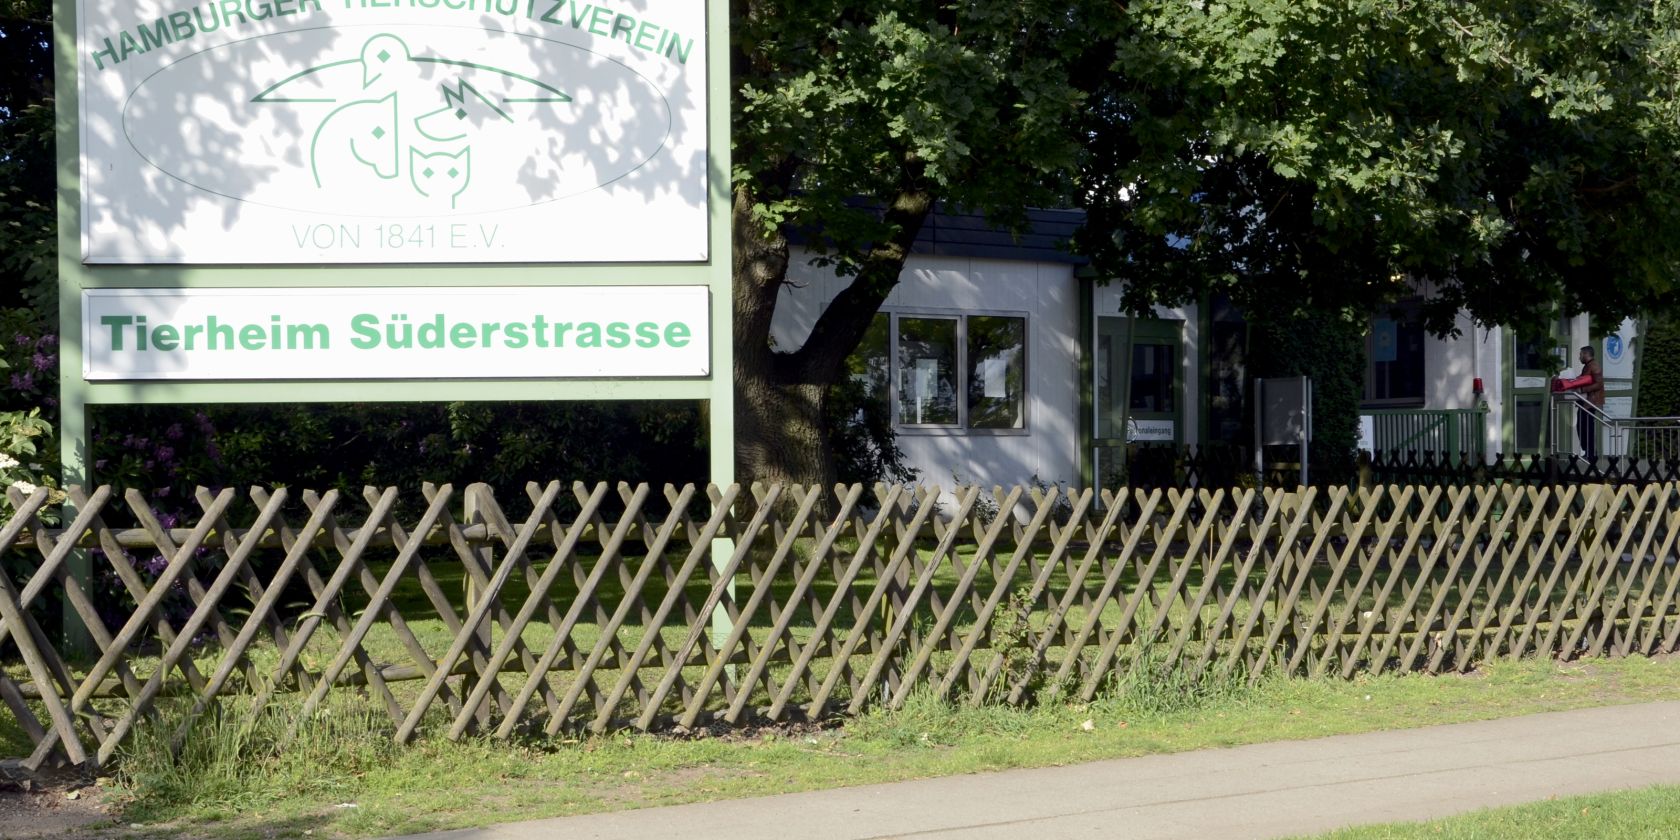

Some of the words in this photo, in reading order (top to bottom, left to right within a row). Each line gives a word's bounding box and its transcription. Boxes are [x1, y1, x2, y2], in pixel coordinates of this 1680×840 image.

[344, 0, 694, 65] UZVEREIN
[291, 223, 360, 249] VON
[375, 223, 435, 249] 1841
[450, 223, 505, 249] E.V.
[101, 314, 330, 352] Tierheim
[351, 313, 691, 350] Süderstrasse
[1137, 426, 1172, 436] onaleingang
